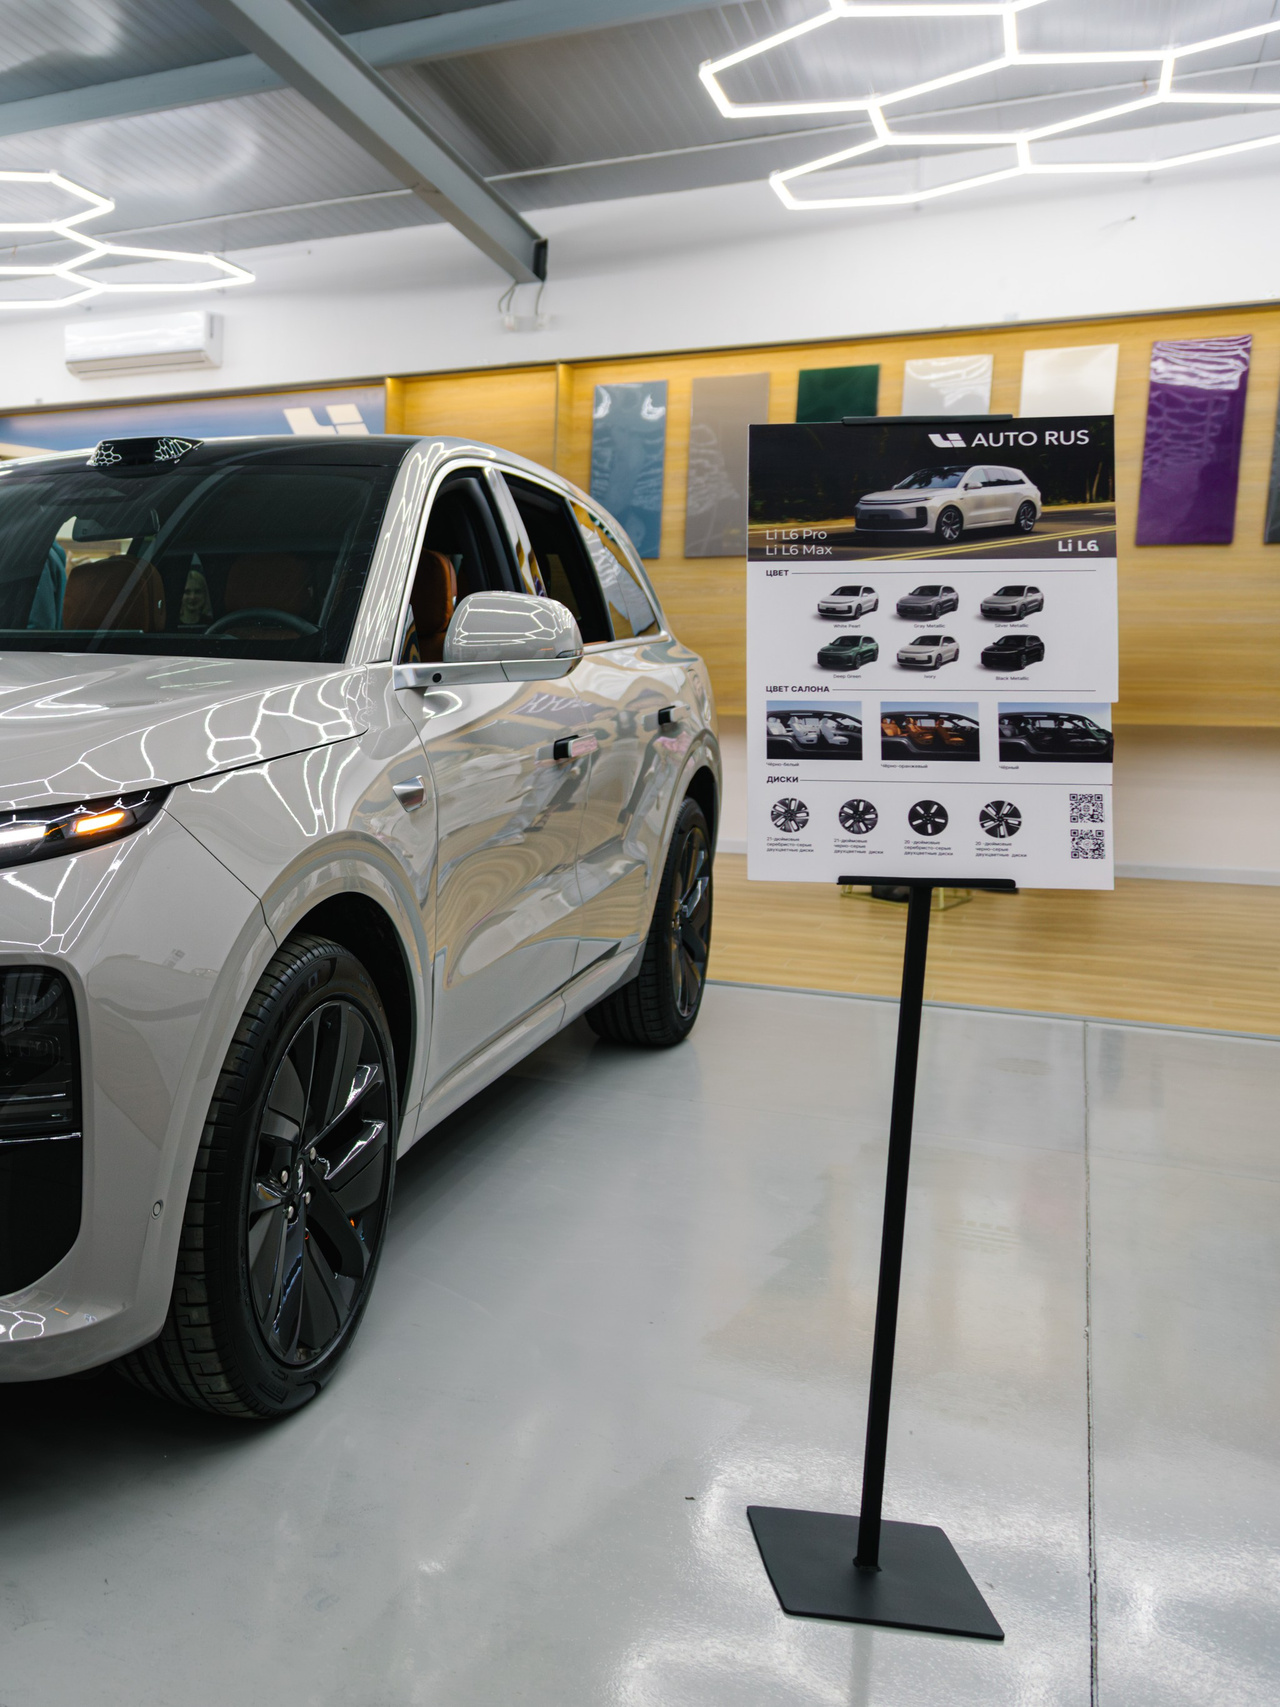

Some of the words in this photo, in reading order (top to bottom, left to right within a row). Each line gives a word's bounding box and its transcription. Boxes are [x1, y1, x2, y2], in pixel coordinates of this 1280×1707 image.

[971, 431, 1038, 447] AUTO
[1045, 429, 1090, 446] RUS
[766, 529, 777, 540] Li
[782, 529, 799, 540] L6
[803, 529, 827, 540] Pro
[766, 544, 777, 555] Li
[782, 544, 799, 555] L6
[803, 544, 833, 555] Max
[1058, 539, 1072, 552] Li
[1078, 540, 1099, 552] L6
[766, 569, 789, 578] ЦВЕТ
[791, 685, 830, 693] САЛОНА
